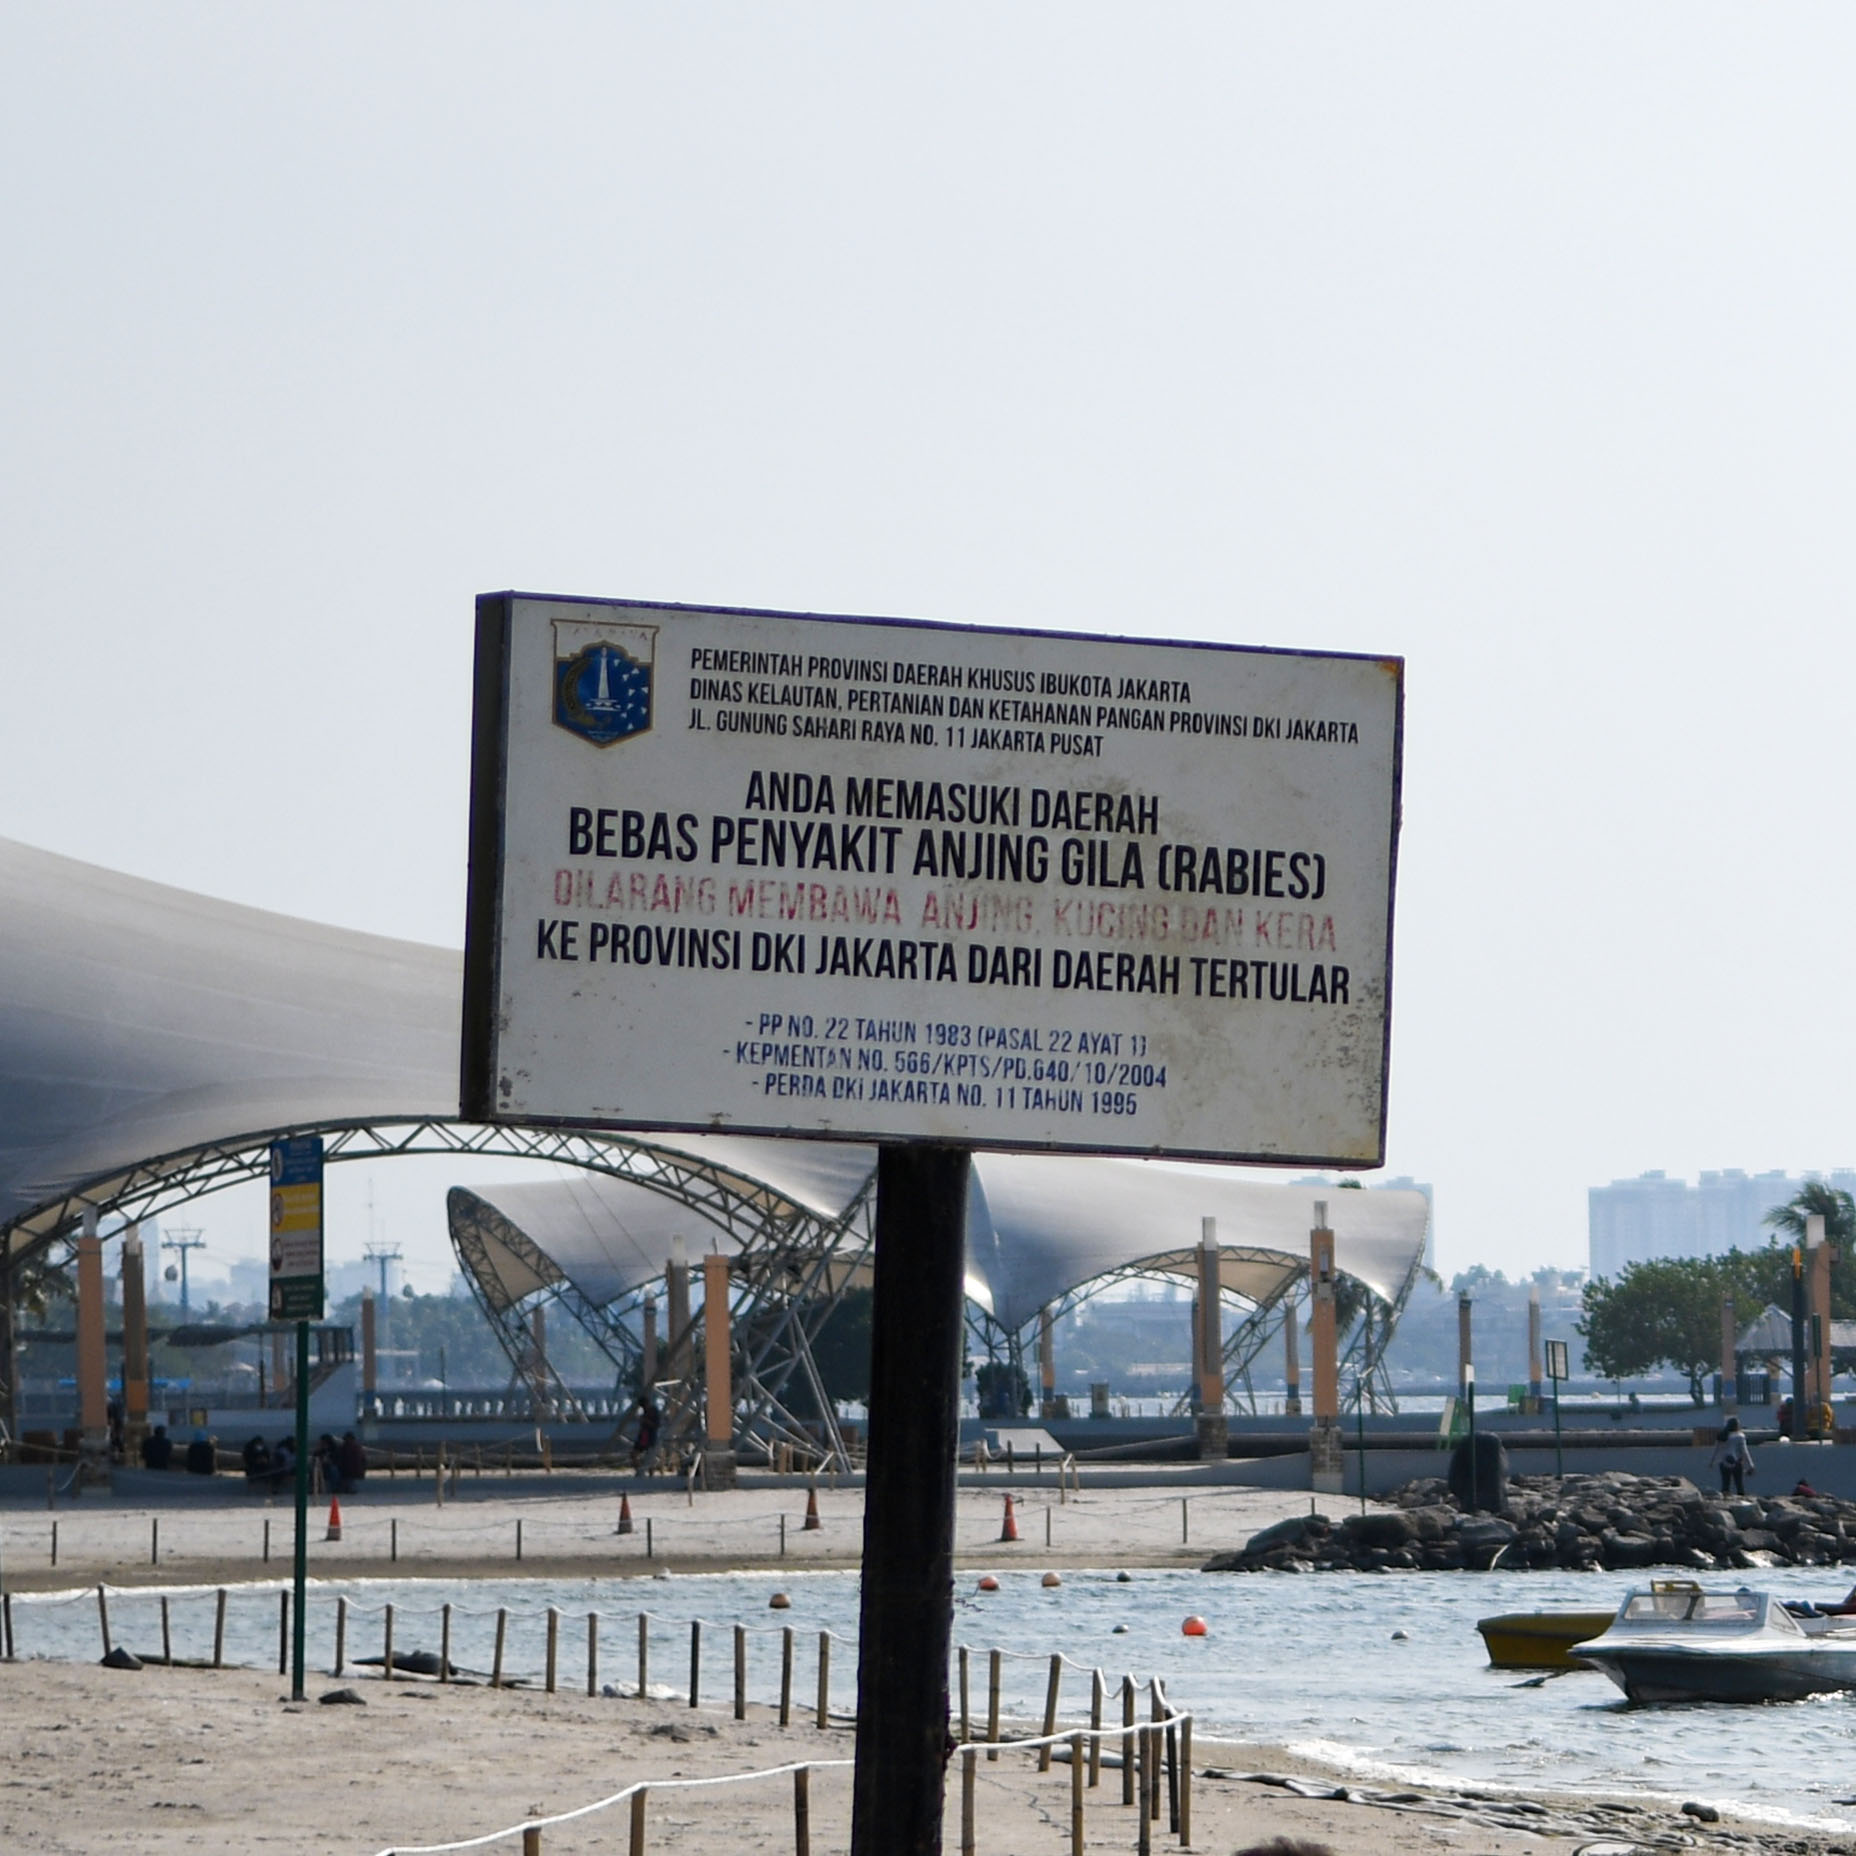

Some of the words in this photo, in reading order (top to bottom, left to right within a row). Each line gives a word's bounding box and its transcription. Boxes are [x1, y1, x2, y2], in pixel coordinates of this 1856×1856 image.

[691, 648, 802, 677] PEMERINTAH
[808, 656, 888, 683] PROVINSI
[893, 662, 962, 688] DAERAH
[967, 667, 1035, 693] KHUSUS
[1040, 672, 1112, 698] IBUKOTA
[1116, 678, 1191, 704] JAKARTA
[688, 709, 711, 731] JL.
[716, 711, 787, 736] GUNUNG
[792, 716, 856, 740] SAHARI
[861, 720, 905, 744] RAYA
[910, 724, 938, 746] NO.
[946, 726, 964, 748] 11
[970, 728, 1045, 753] JAKARTA
[1050, 733, 1104, 757] PUSAT
[690, 678, 743, 703] DINAS
[747, 682, 842, 712] KELAUTAN,
[847, 689, 943, 716] PERTANIAN
[949, 696, 984, 719] DAN
[989, 699, 1091, 726] KETAHANAN
[1096, 706, 1165, 732] PANGAN
[1170, 711, 1247, 737] PROVINSI
[1253, 716, 1280, 739] DKI
[1285, 718, 1358, 744] JAKARTA
[745, 770, 835, 815] ANDA
[846, 777, 1020, 827] MEMASUKI
[1031, 789, 1158, 836] DAERAH
[569, 807, 699, 862] BEBAS
[711, 816, 903, 874] PENYAKIT
[913, 829, 1048, 884] ANJING
[1061, 838, 1145, 889] GILA
[1158, 844, 1325, 900] (RABIES)
[554, 868, 716, 916] DILARANG
[728, 879, 901, 926] MEMBAWA
[1053, 896, 1169, 942] KUCING
[1256, 909, 1337, 953] KERA
[537, 919, 579, 961] KE
[588, 922, 740, 970] PROVINSI
[751, 932, 805, 974] DKI
[815, 936, 957, 982] JAKARTA
[968, 945, 1041, 987] DARI
[1053, 950, 1180, 996] DAERAH
[1189, 959, 1349, 1004] TERTULAR
[736, 1041, 851, 1070] KEPMENTAN
[858, 1049, 888, 1072] NO.
[759, 1013, 783, 1036] PP
[788, 1015, 818, 1039] NO.
[825, 1017, 849, 1040] 22
[855, 1018, 916, 1043] TAHUN
[926, 1023, 971, 1047] 1983
[978, 1026, 1043, 1052] (PASAL
[1048, 1030, 1072, 1053] 22
[1078, 1032, 1123, 1056] AYAT
[764, 1072, 827, 1098] PERDA
[832, 1076, 863, 1101] DKI
[869, 1079, 950, 1105] JAKARTA
[957, 1084, 986, 1107] NO.
[997, 1087, 1015, 1109] 11
[1022, 1088, 1082, 1112] TAHUN
[1092, 1092, 1137, 1115] 1995
